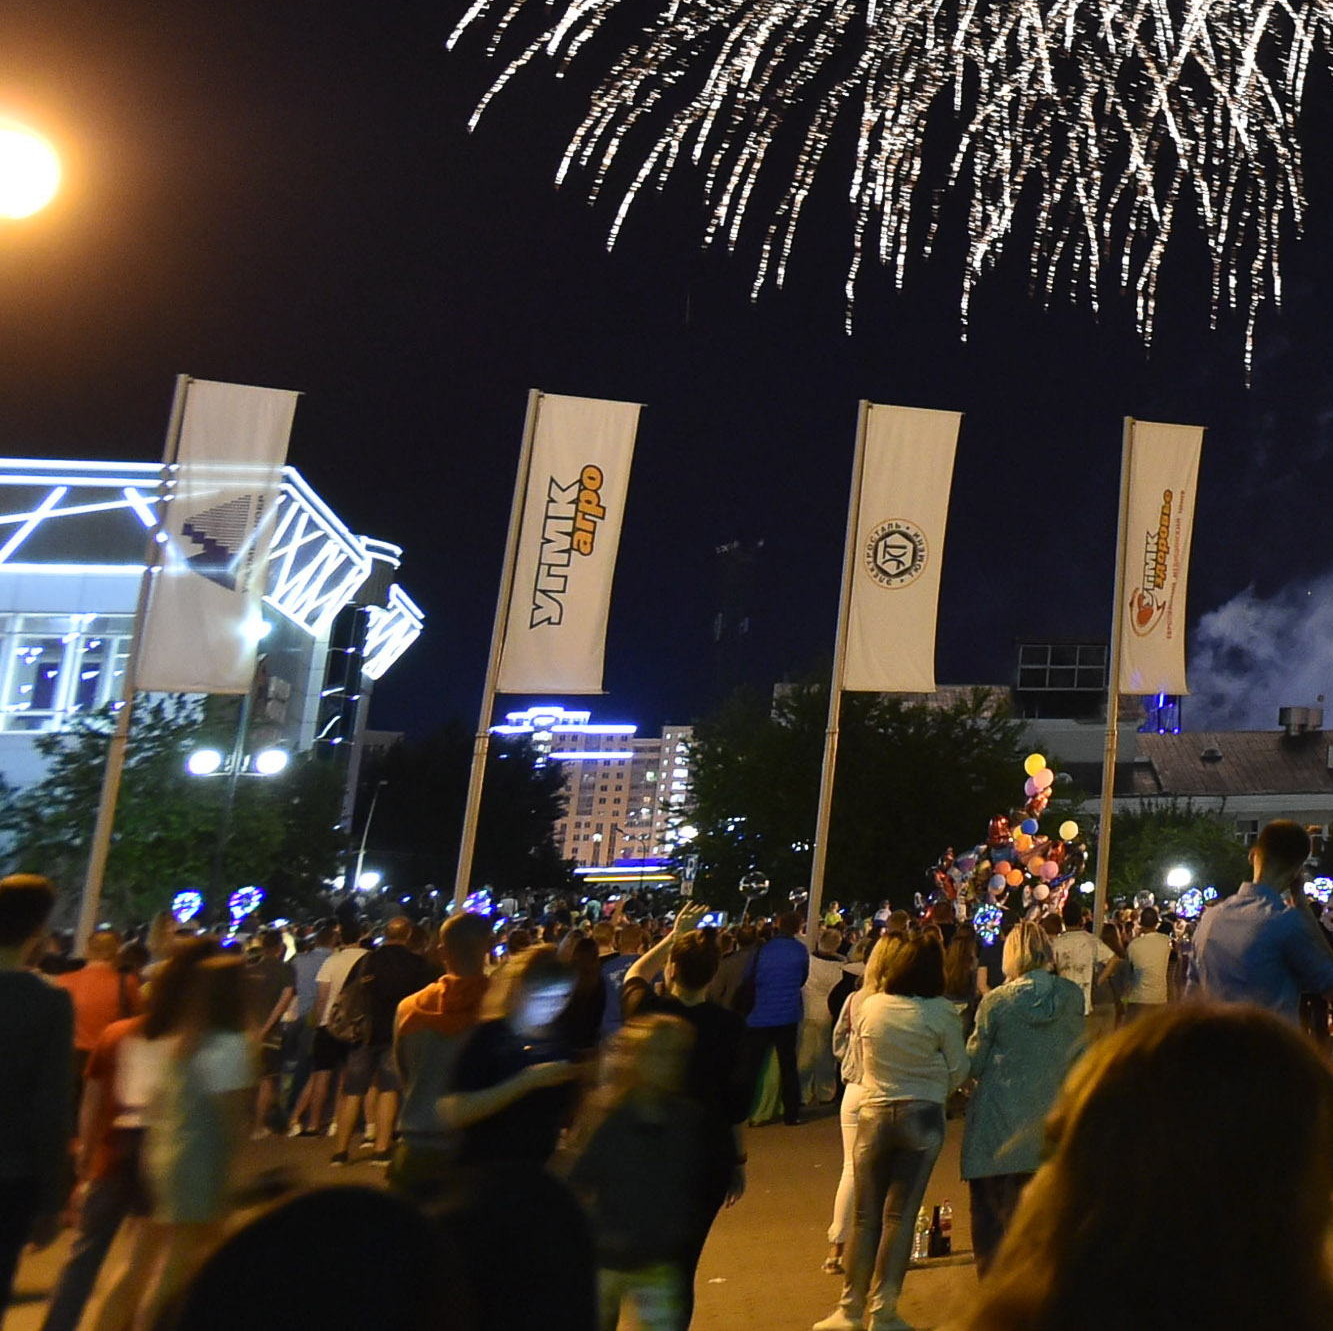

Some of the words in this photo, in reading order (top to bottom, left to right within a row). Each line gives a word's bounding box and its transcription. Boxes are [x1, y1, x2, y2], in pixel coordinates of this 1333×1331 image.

[571, 464, 606, 557] агро
[529, 474, 581, 630] УГМК
[866, 522, 901, 587] ЭЛЕКТРОСТАЛЬ
[908, 531, 925, 578] ТЮМЕНИ
[1142, 530, 1159, 607] УГМК
